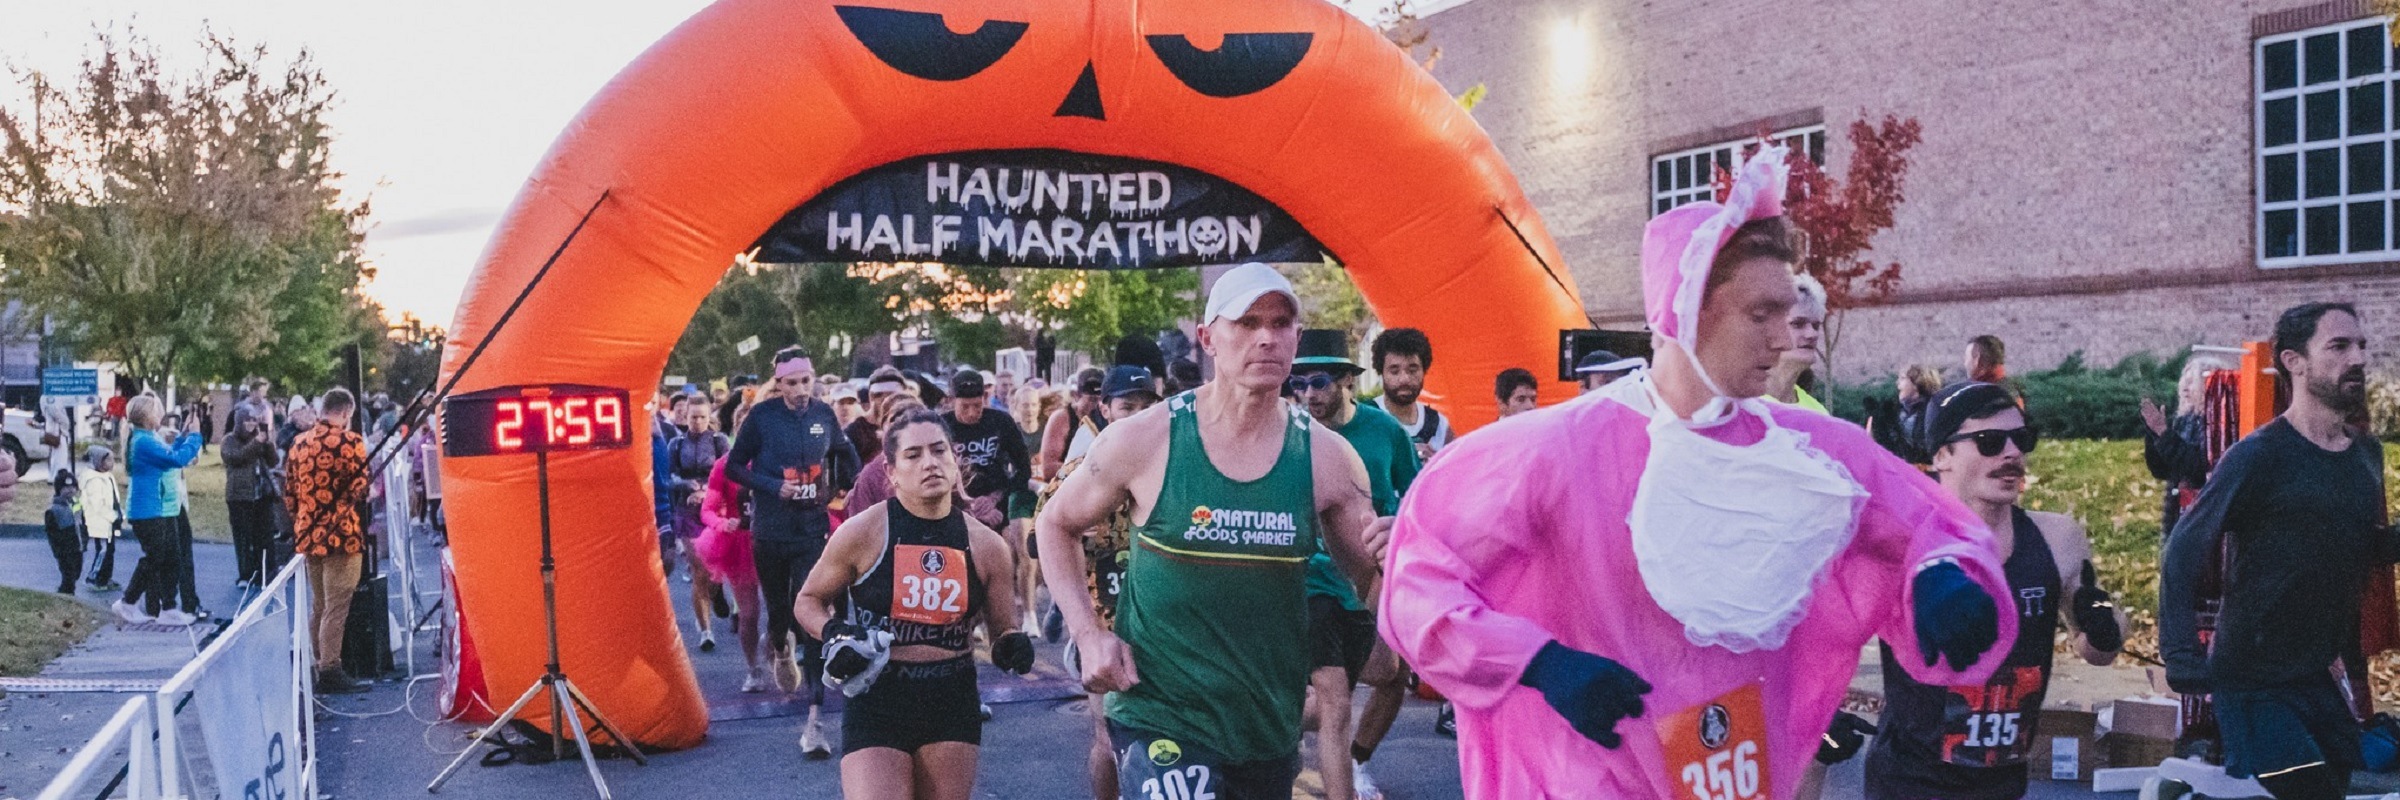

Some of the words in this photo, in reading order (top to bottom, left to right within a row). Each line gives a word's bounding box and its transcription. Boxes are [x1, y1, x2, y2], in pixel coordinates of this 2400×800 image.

[928, 162, 1171, 219] HAUNTED
[827, 210, 962, 260] HALF
[496, 397, 623, 447] 27:59
[968, 436, 998, 453] ONE
[1184, 525, 1238, 544] FOODS
[1242, 530, 1297, 546] MARKET
[1211, 508, 1297, 531] NATURAL
[902, 575, 961, 612] 382
[890, 620, 938, 642] NIKE
[1963, 712, 2021, 747] 135
[1142, 765, 1216, 800] 302
[1681, 740, 1760, 800] 356
